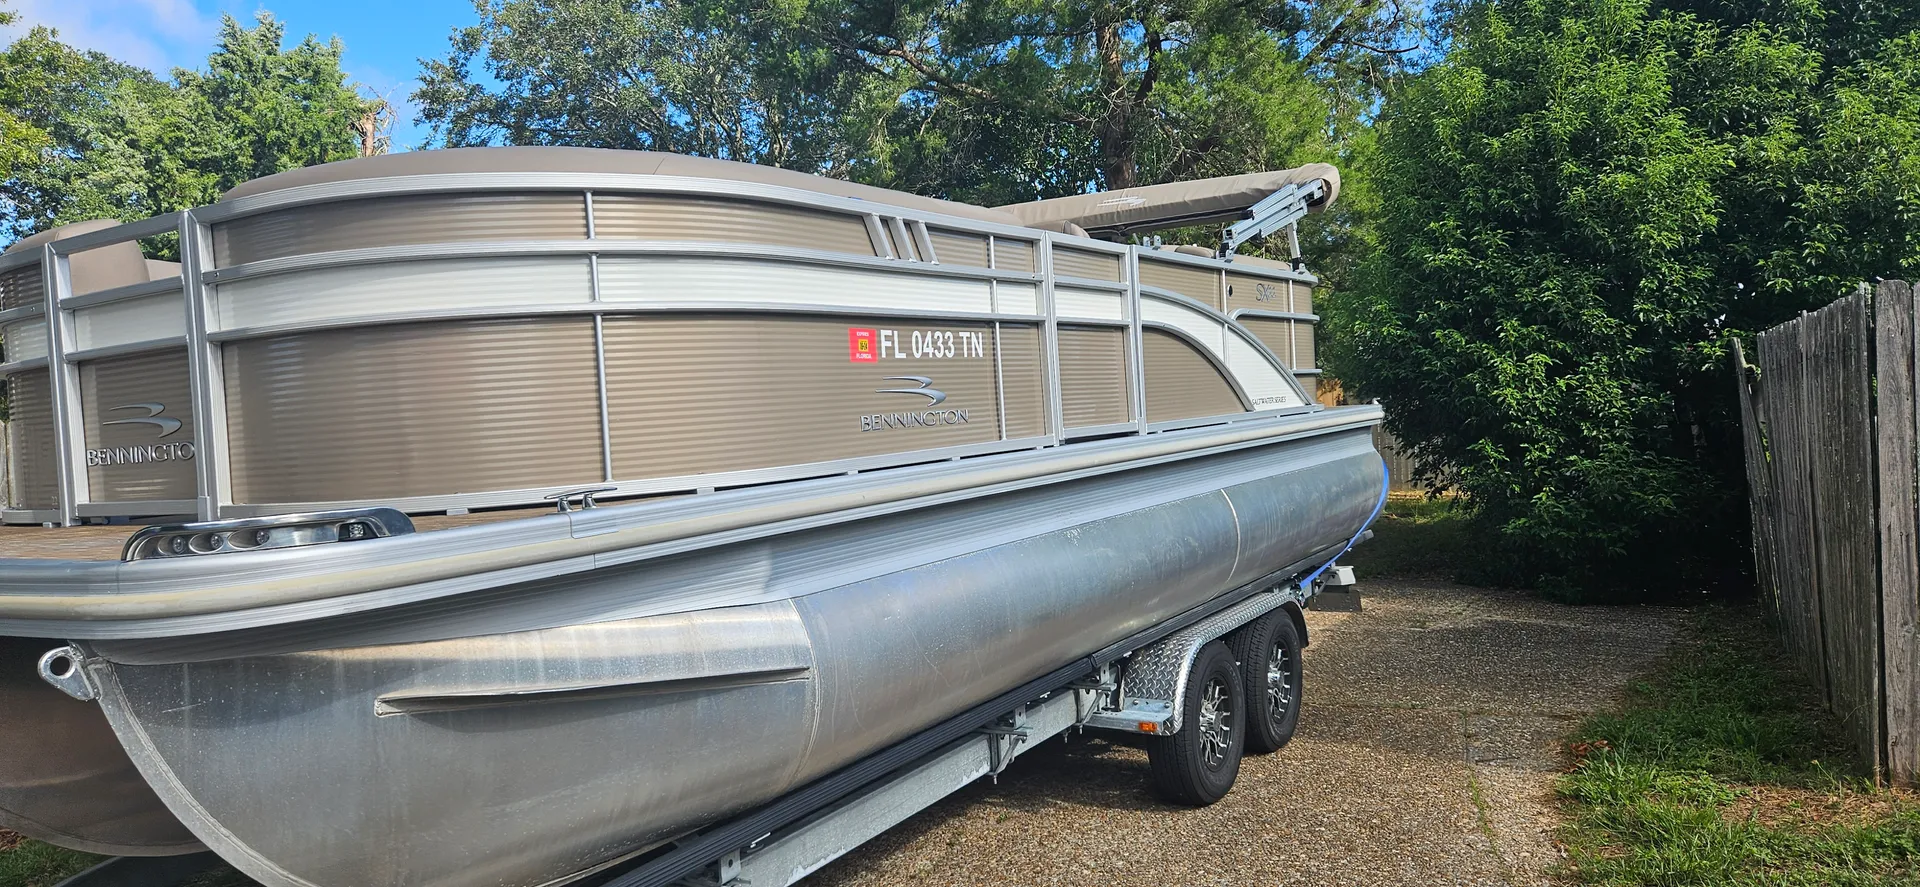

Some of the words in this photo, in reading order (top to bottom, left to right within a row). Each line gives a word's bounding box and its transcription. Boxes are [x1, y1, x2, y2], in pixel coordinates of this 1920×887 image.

[880, 329, 907, 358] FL
[911, 330, 955, 359] 0433
[958, 331, 984, 358] TN
[860, 409, 969, 432] BENNINGTON
[86, 441, 196, 467] BENNINGTO
